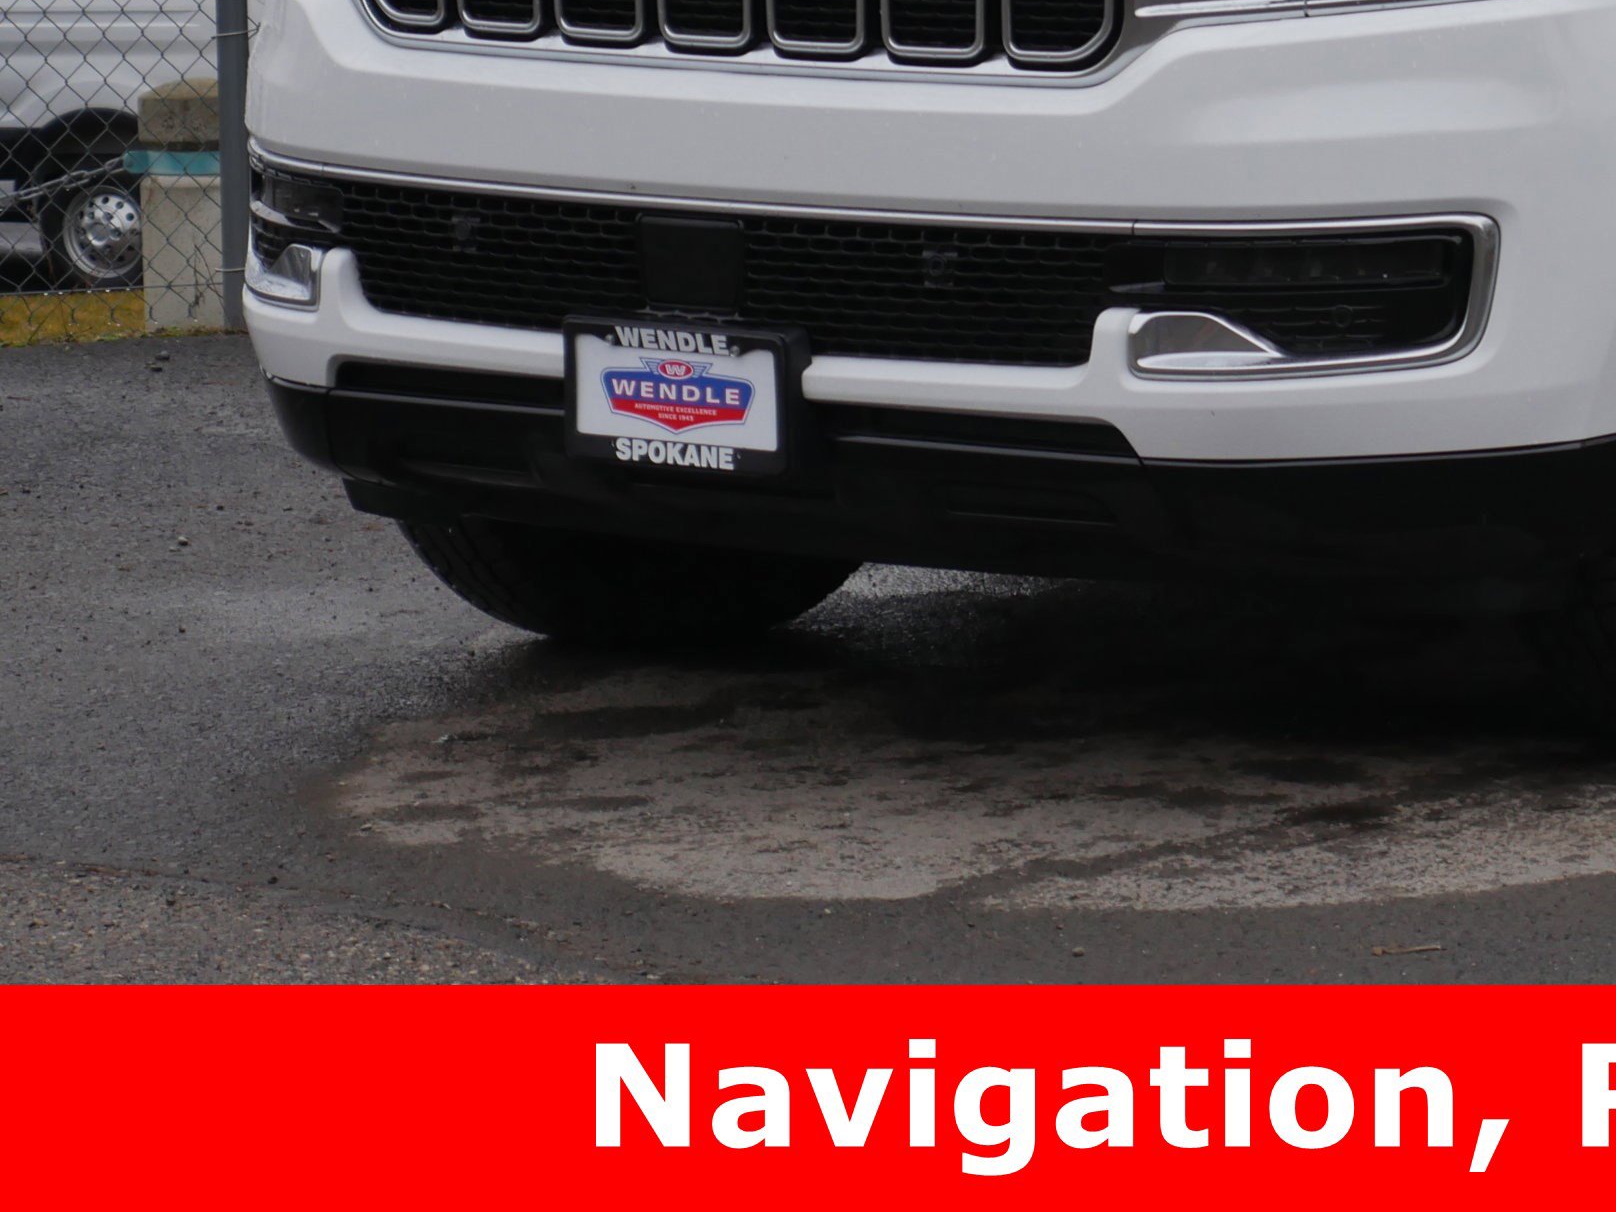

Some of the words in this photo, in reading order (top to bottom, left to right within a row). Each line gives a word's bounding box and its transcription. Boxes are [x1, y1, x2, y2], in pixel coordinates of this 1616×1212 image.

[614, 325, 731, 356] WENDLE
[611, 378, 741, 405] WENDLE
[634, 402, 675, 413] AUTOMOTIVE
[676, 406, 718, 417] EXCELLENCE
[658, 412, 678, 421] SINCE
[615, 437, 735, 470] SPOKANE
